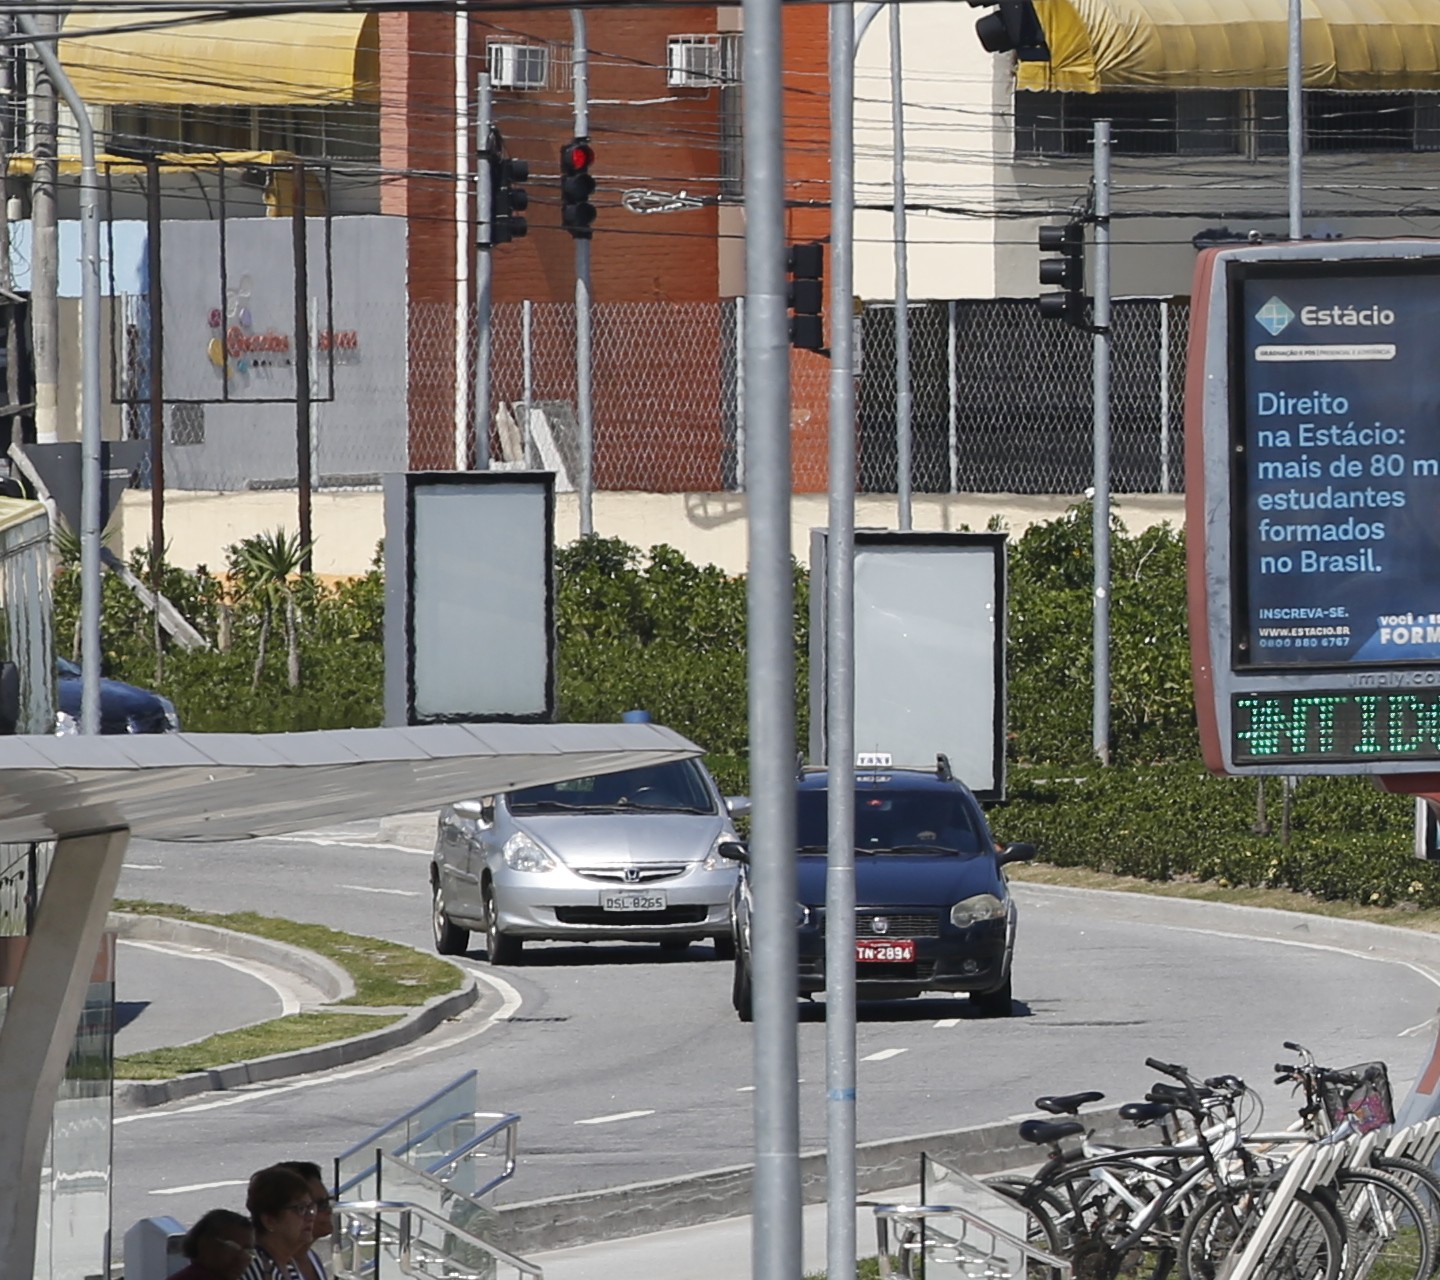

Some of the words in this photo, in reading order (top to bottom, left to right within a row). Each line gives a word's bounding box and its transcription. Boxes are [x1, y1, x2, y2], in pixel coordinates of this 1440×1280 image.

[1301, 305, 1395, 326] Estácio
[1257, 390, 1349, 416] Direito
[1257, 429, 1292, 448] na
[1298, 421, 1406, 448] Estácio:
[1257, 454, 1322, 480] mais
[1329, 454, 1363, 477] de
[1369, 453, 1405, 477] 80
[1257, 485, 1406, 511] estudantes
[1258, 516, 1386, 542] formados
[1260, 555, 1293, 574] no
[1301, 547, 1383, 573] Brasil.
[1258, 607, 1350, 620] INSCREVA-SE.
[1379, 612, 1414, 627] VOCÊ
[1258, 626, 1351, 637] WWW.ESTACIO.BR
[1258, 638, 1291, 649] 0800
[1294, 638, 1318, 648] 880
[1320, 637, 1351, 648] 6767
[859, 756, 890, 765] TAXI
